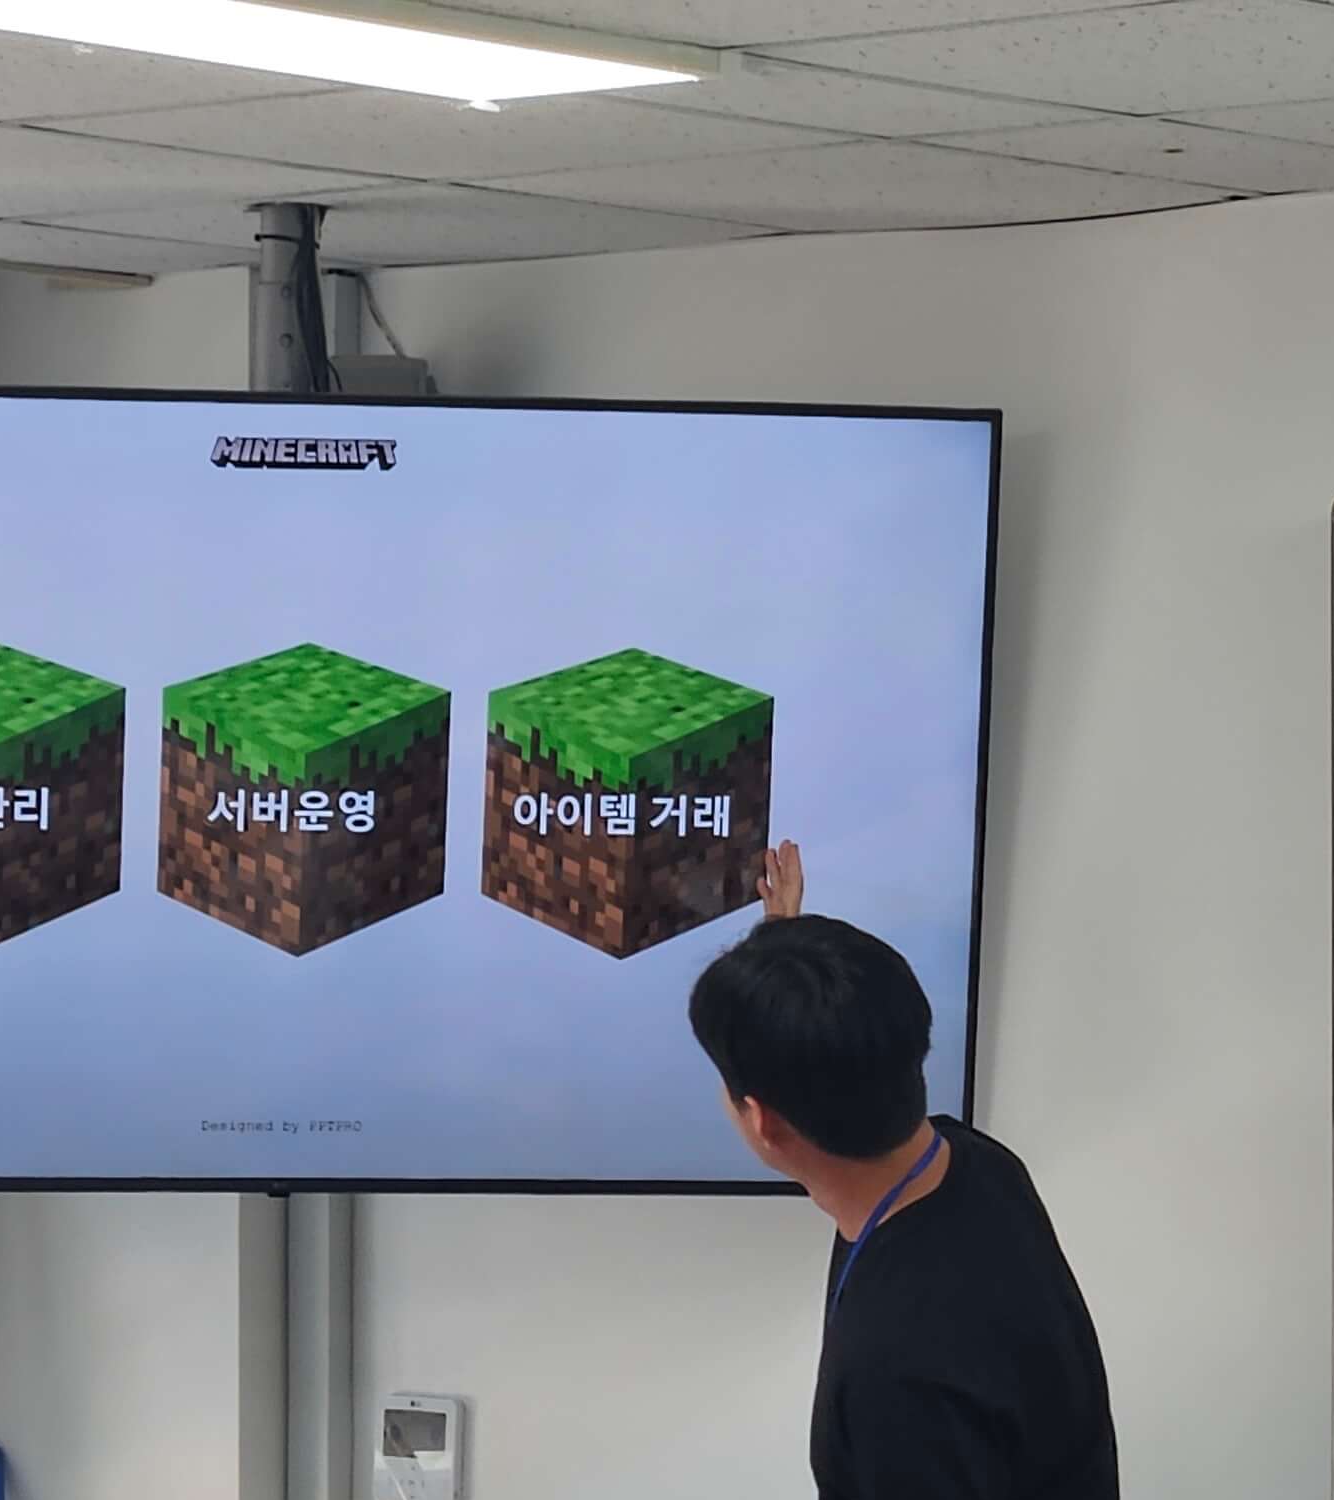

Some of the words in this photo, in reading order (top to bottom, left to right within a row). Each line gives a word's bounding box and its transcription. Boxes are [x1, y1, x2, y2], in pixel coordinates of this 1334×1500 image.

[210, 436, 397, 471] MINECRAFT
[207, 788, 377, 834] 서버운영
[513, 792, 637, 837] 아이템
[650, 794, 731, 838] 거래
[201, 1119, 275, 1134] Designed
[281, 1119, 300, 1134] by
